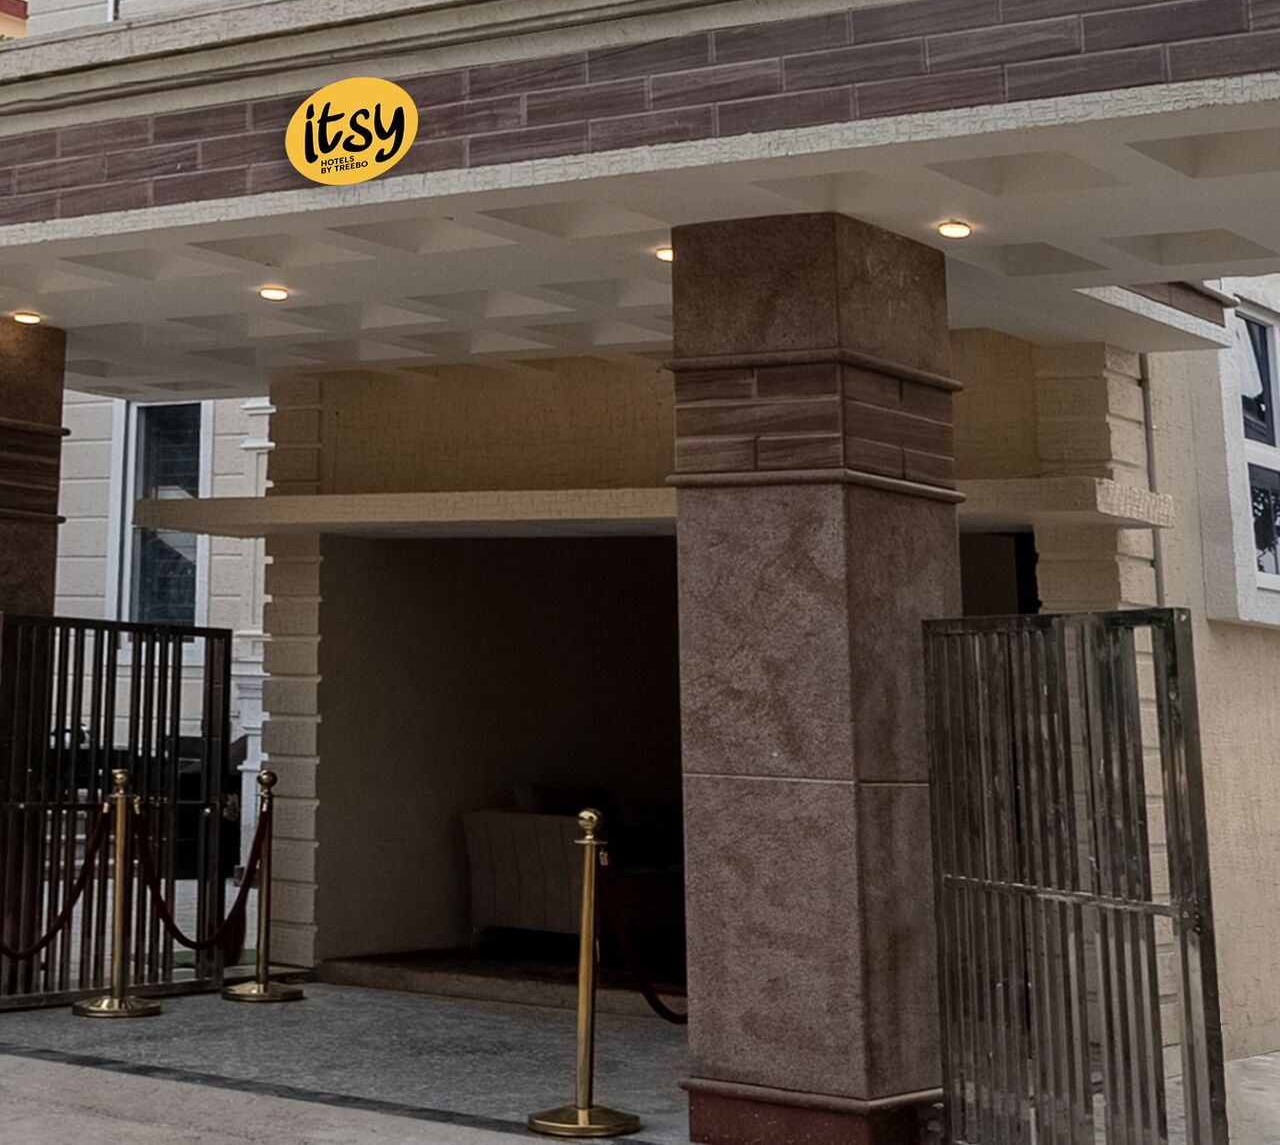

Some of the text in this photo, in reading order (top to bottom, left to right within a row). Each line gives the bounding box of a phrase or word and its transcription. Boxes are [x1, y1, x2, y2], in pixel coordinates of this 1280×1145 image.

[305, 102, 405, 163] itsy
[321, 156, 355, 167] HOTELS
[334, 161, 369, 172] TREEBO
